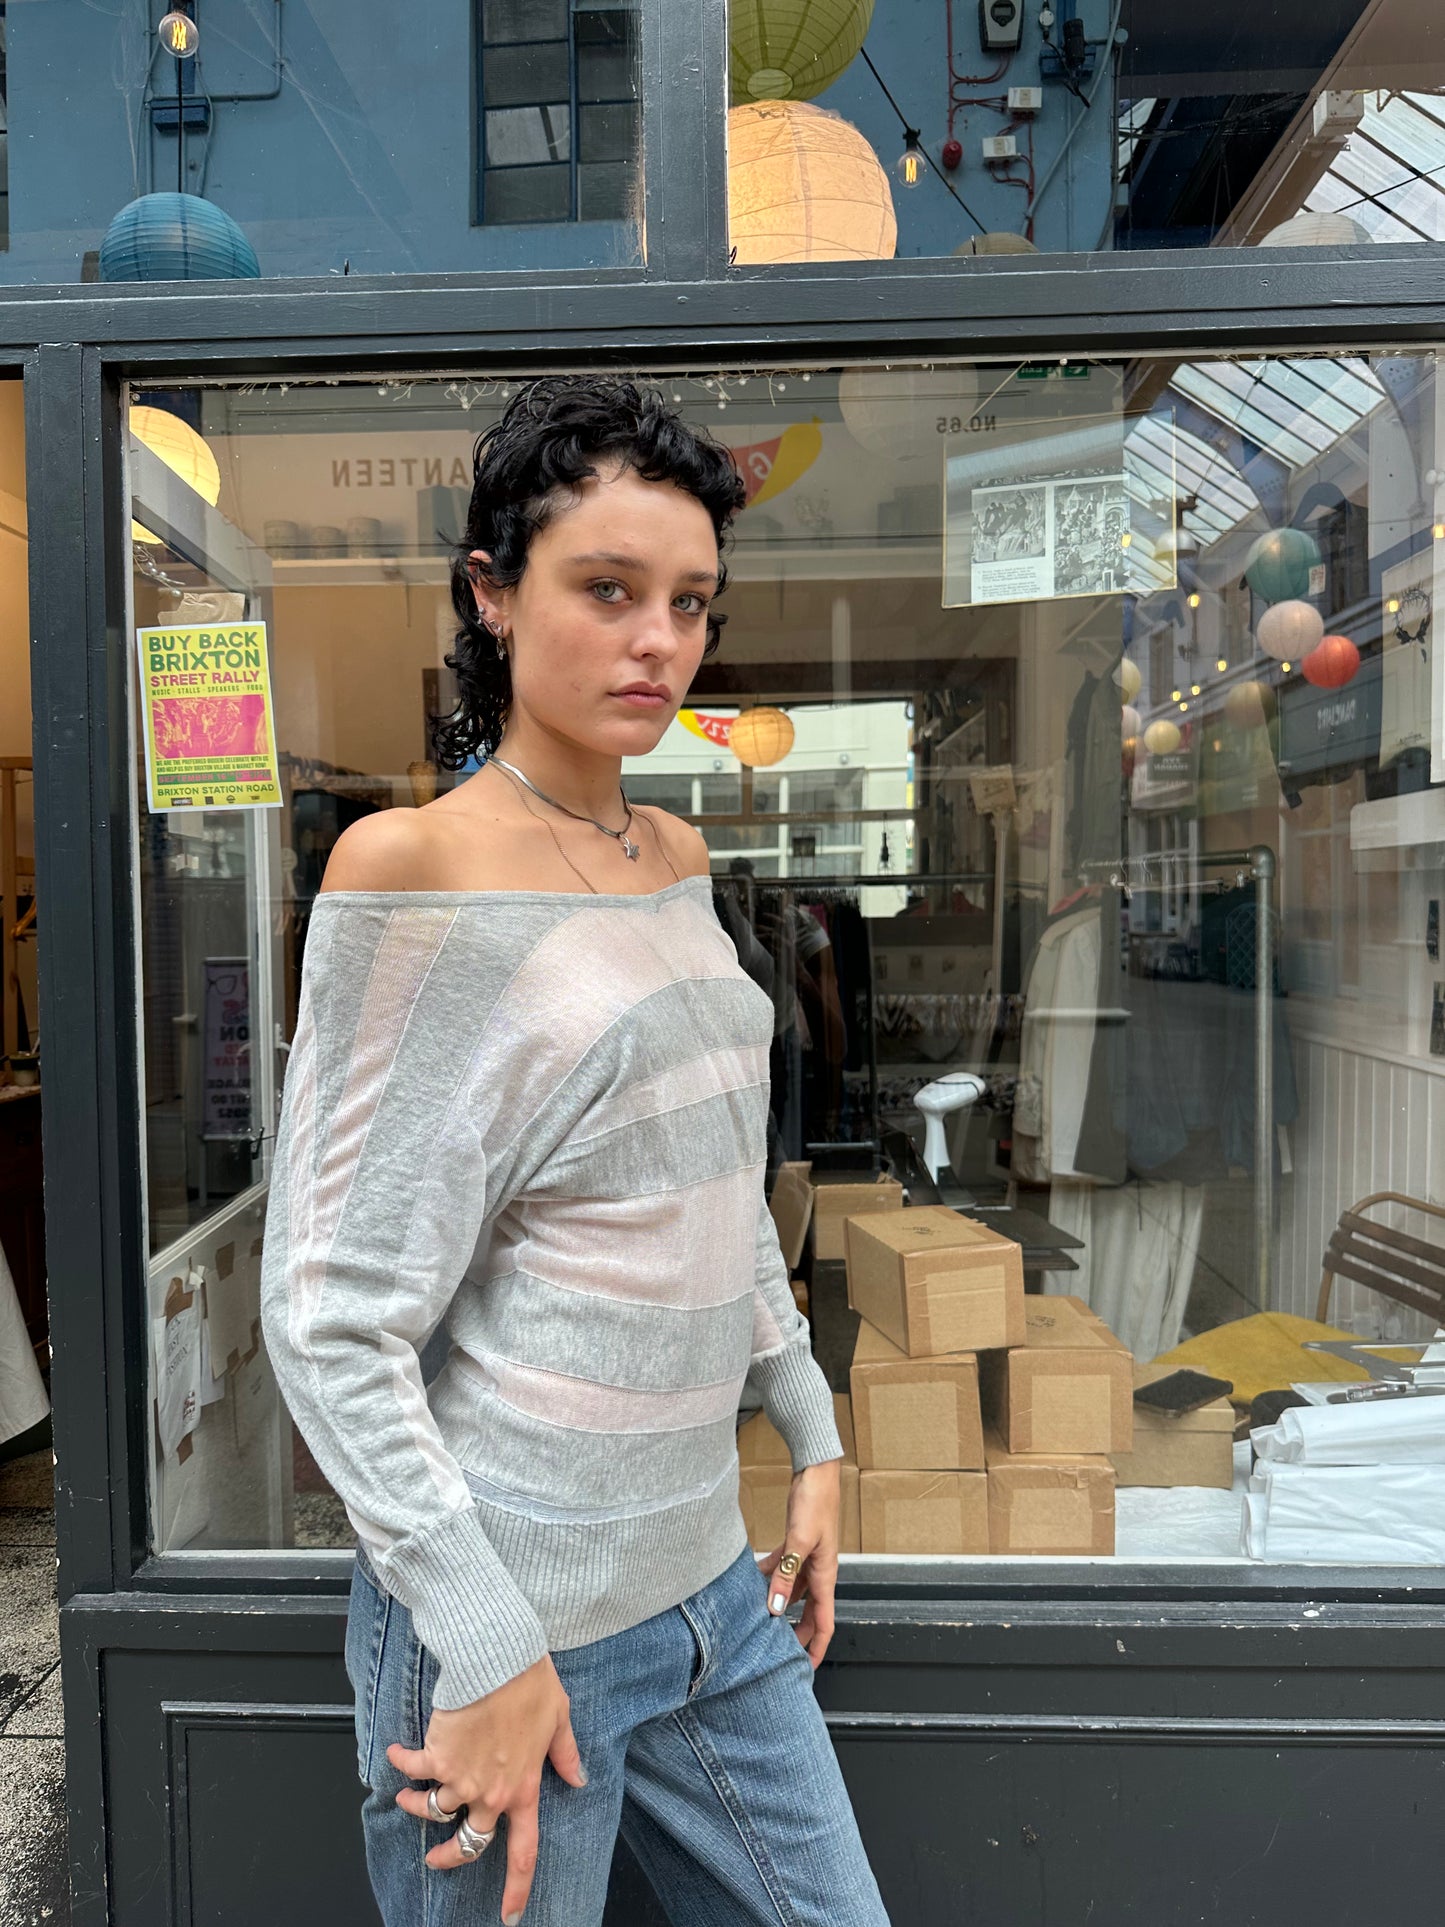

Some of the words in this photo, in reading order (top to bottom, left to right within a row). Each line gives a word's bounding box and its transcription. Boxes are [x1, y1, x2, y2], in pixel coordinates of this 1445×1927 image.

[149, 635, 191, 652] BUY
[199, 632, 258, 649] BACK
[150, 649, 261, 672] BRIXTON
[150, 673, 207, 687] STREET
[212, 670, 260, 684] RALLY
[152, 688, 171, 696] MUSIC
[207, 685, 240, 693] SPEAKERS
[157, 787, 199, 796] BRIXTON
[202, 785, 243, 794] STATION
[246, 783, 275, 792] ROAD
